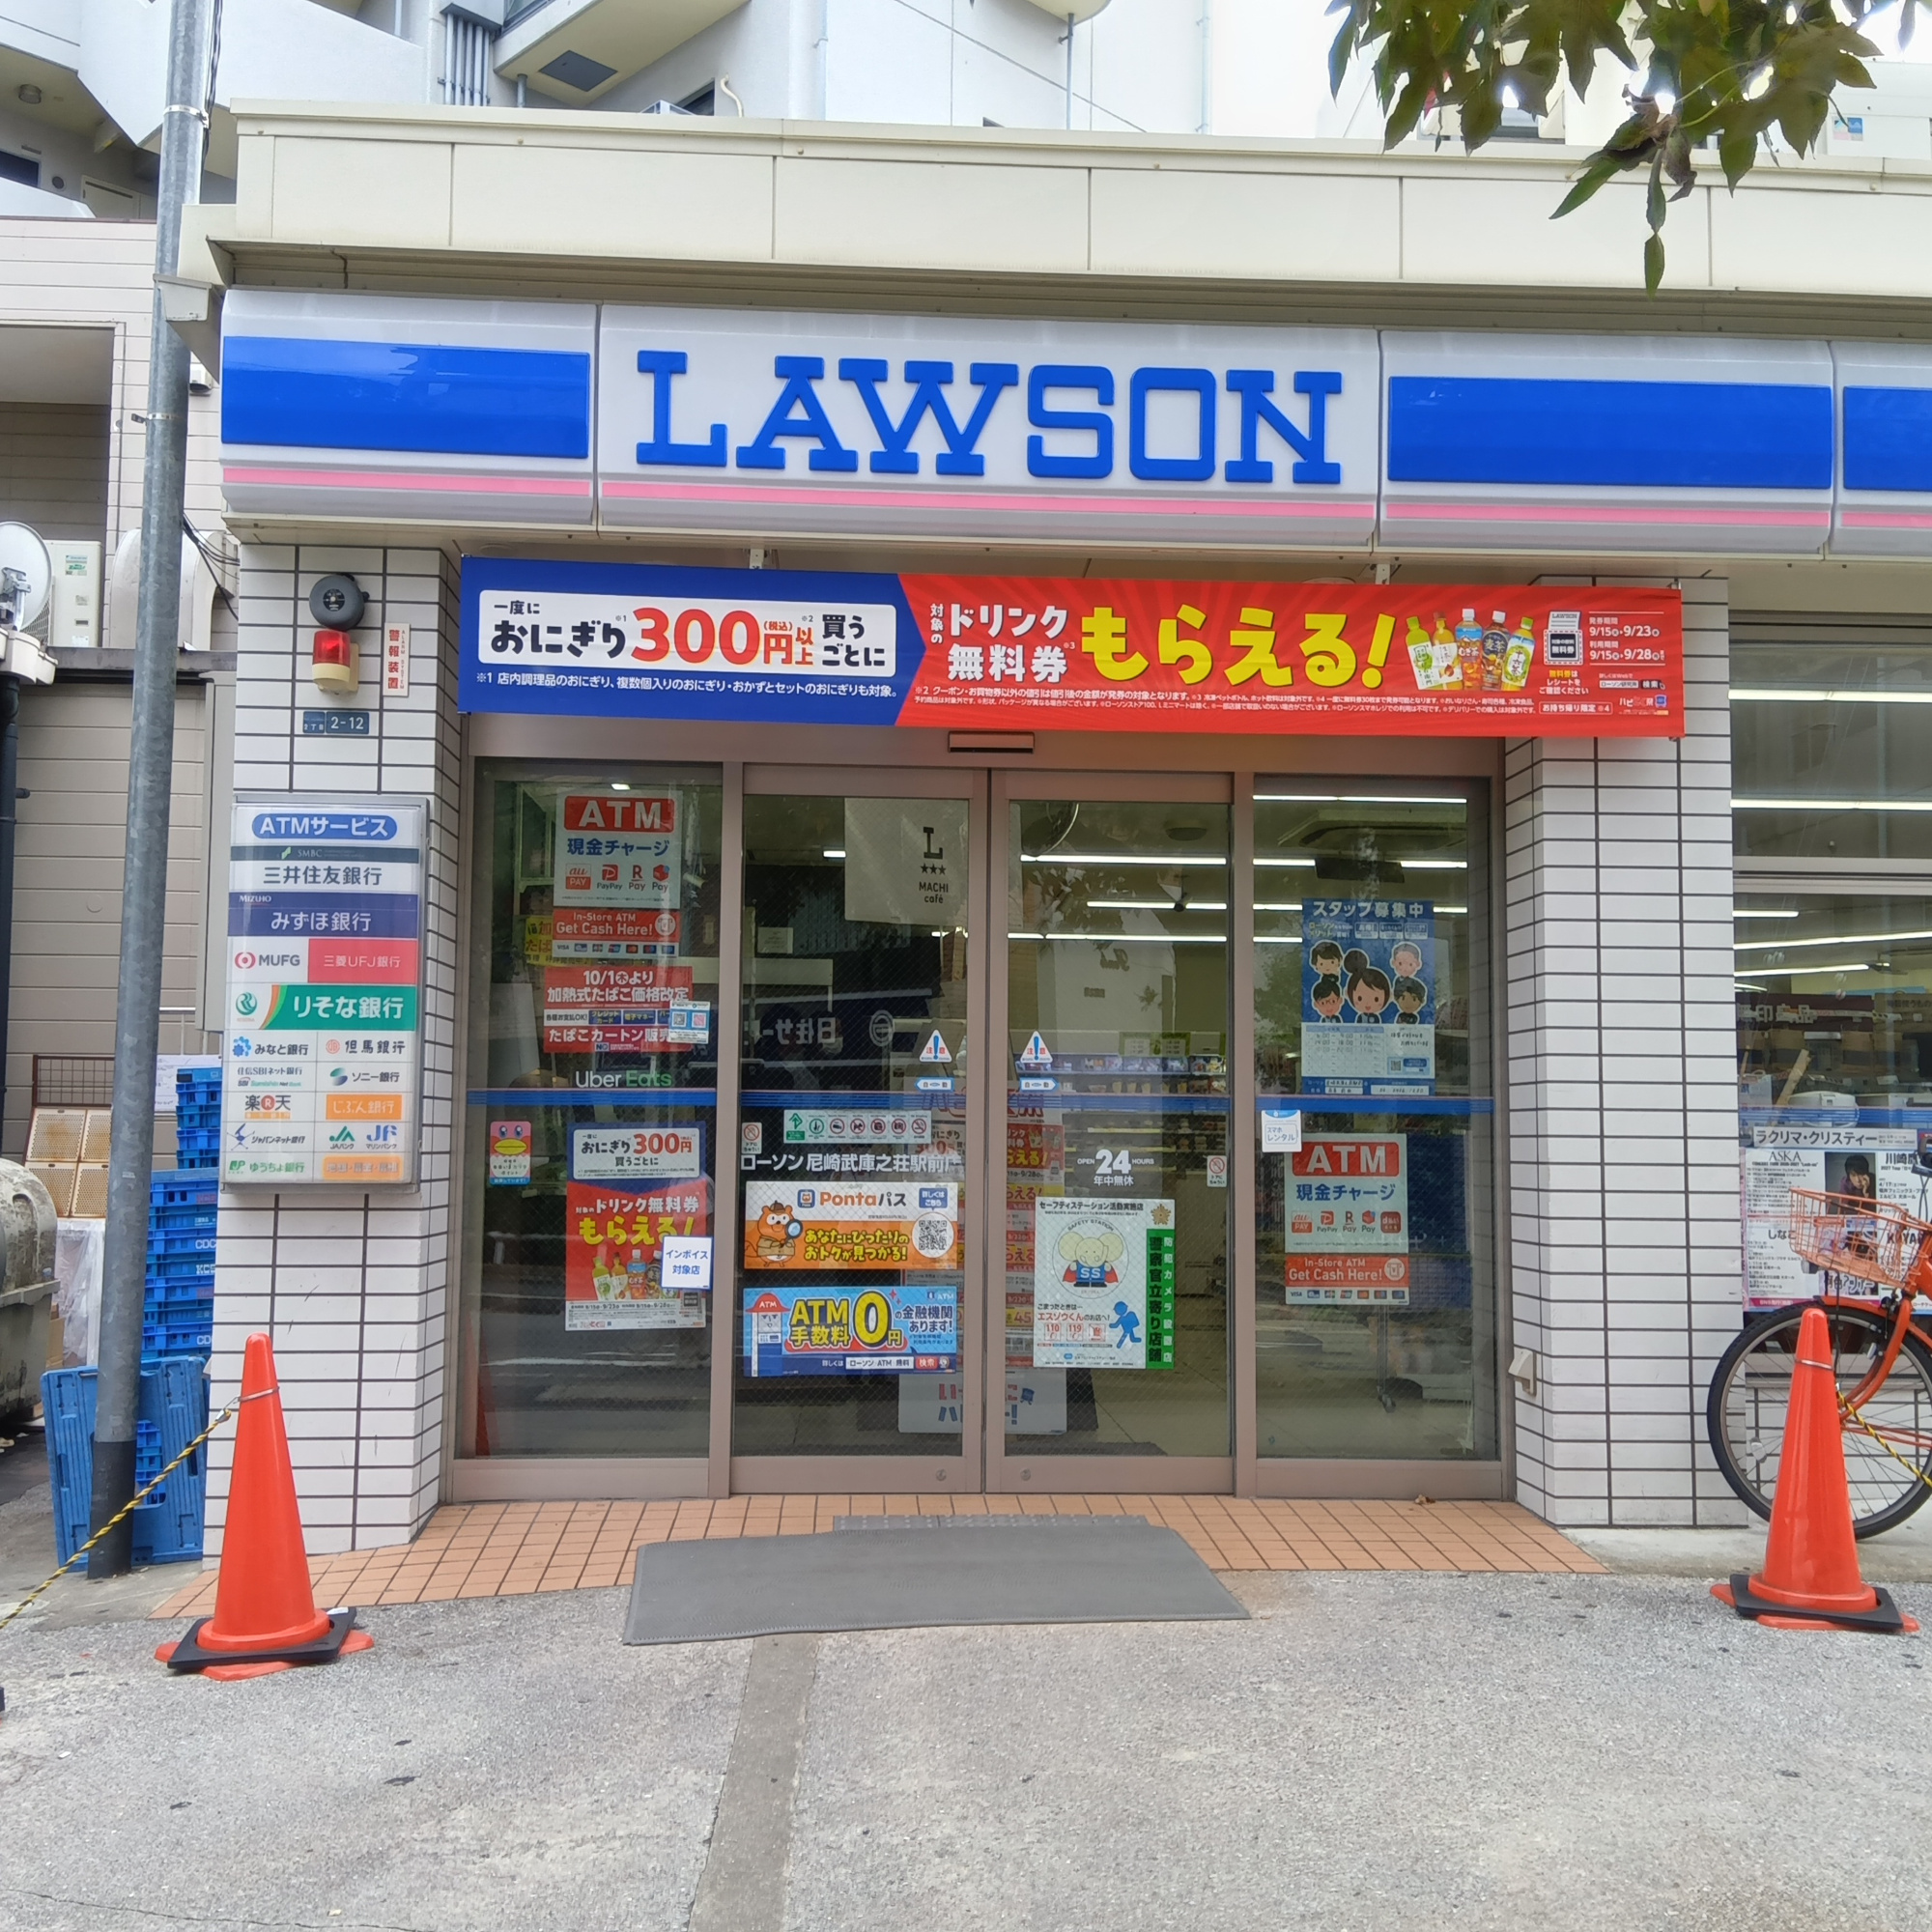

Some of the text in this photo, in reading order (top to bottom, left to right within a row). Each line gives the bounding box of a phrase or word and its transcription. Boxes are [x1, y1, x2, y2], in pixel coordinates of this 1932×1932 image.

[637, 350, 1342, 484] LAWSON
[494, 600, 540, 615] 一度に
[822, 614, 865, 639] 買う
[930, 603, 944, 644] 対象の
[951, 604, 1067, 639] ドリンク
[491, 620, 626, 659] おにぎり
[387, 629, 400, 690] 警報装置
[822, 643, 886, 667] ごとに
[948, 643, 1067, 683] 無料券
[1547, 678, 1580, 687] レシートを
[330, 717, 364, 729] 2-12
[578, 800, 662, 830] ATM
[259, 816, 388, 838] ATMサービス
[298, 849, 323, 858] SMBC
[567, 838, 670, 857] 現金チャージ
[263, 866, 383, 886] 三井住友銀行
[569, 878, 586, 887] PAY
[629, 882, 646, 892] Pay
[652, 882, 668, 893] Pay
[919, 881, 949, 893] MACHI
[239, 895, 271, 904] MIZUHO
[924, 894, 944, 903] café
[573, 912, 636, 922] In-Store ATM
[1313, 901, 1424, 919] スタッフ募集中
[271, 911, 371, 932] みずほ銀行
[556, 922, 653, 936] Get Cash Here!
[259, 954, 300, 967] MUFG
[324, 954, 401, 968] 三菱UFJ銀行
[547, 987, 689, 1003] 加熱式たばこ価格改定
[294, 996, 404, 1020] りそな銀行
[254, 1043, 309, 1056] みなと銀行
[345, 1039, 406, 1055] 但馬銀行
[237, 1066, 303, 1076] 住信SBIネット銀行
[352, 1071, 400, 1083] ソニー銀行
[576, 1070, 673, 1088] Uber Eats
[332, 1100, 394, 1115] じぶん銀行
[1267, 1133, 1295, 1142] レンタル
[1755, 1129, 1878, 1147] ラクリマ・クリスティー
[582, 1140, 631, 1154] おにぎり
[615, 1156, 659, 1167] 買うごとに
[741, 1154, 804, 1171] ローソン
[1095, 1149, 1131, 1175] 24
[1306, 1145, 1386, 1173] ATM
[1768, 1151, 1803, 1162] ASKA
[249, 1162, 305, 1174] ゆうちょ銀行
[1093, 1176, 1134, 1186] 年中無休
[1296, 1183, 1396, 1201] 現金チャージ
[805, 1229, 909, 1244] あなたにぴったりの
[1361, 1225, 1376, 1234] Pay
[666, 1250, 709, 1260] インボイス
[1305, 1258, 1366, 1267] In-Store ATM
[672, 1265, 700, 1275] 対象店
[1079, 1267, 1101, 1279] SS
[1289, 1267, 1382, 1281] Get Cash Here!
[790, 1299, 849, 1325] ATM
[895, 1305, 953, 1320] の金融機関
[909, 1320, 953, 1333] あります!
[1046, 1323, 1060, 1332] 110
[197, 1335, 212, 1345] CD
[790, 1324, 850, 1346] 手数料
